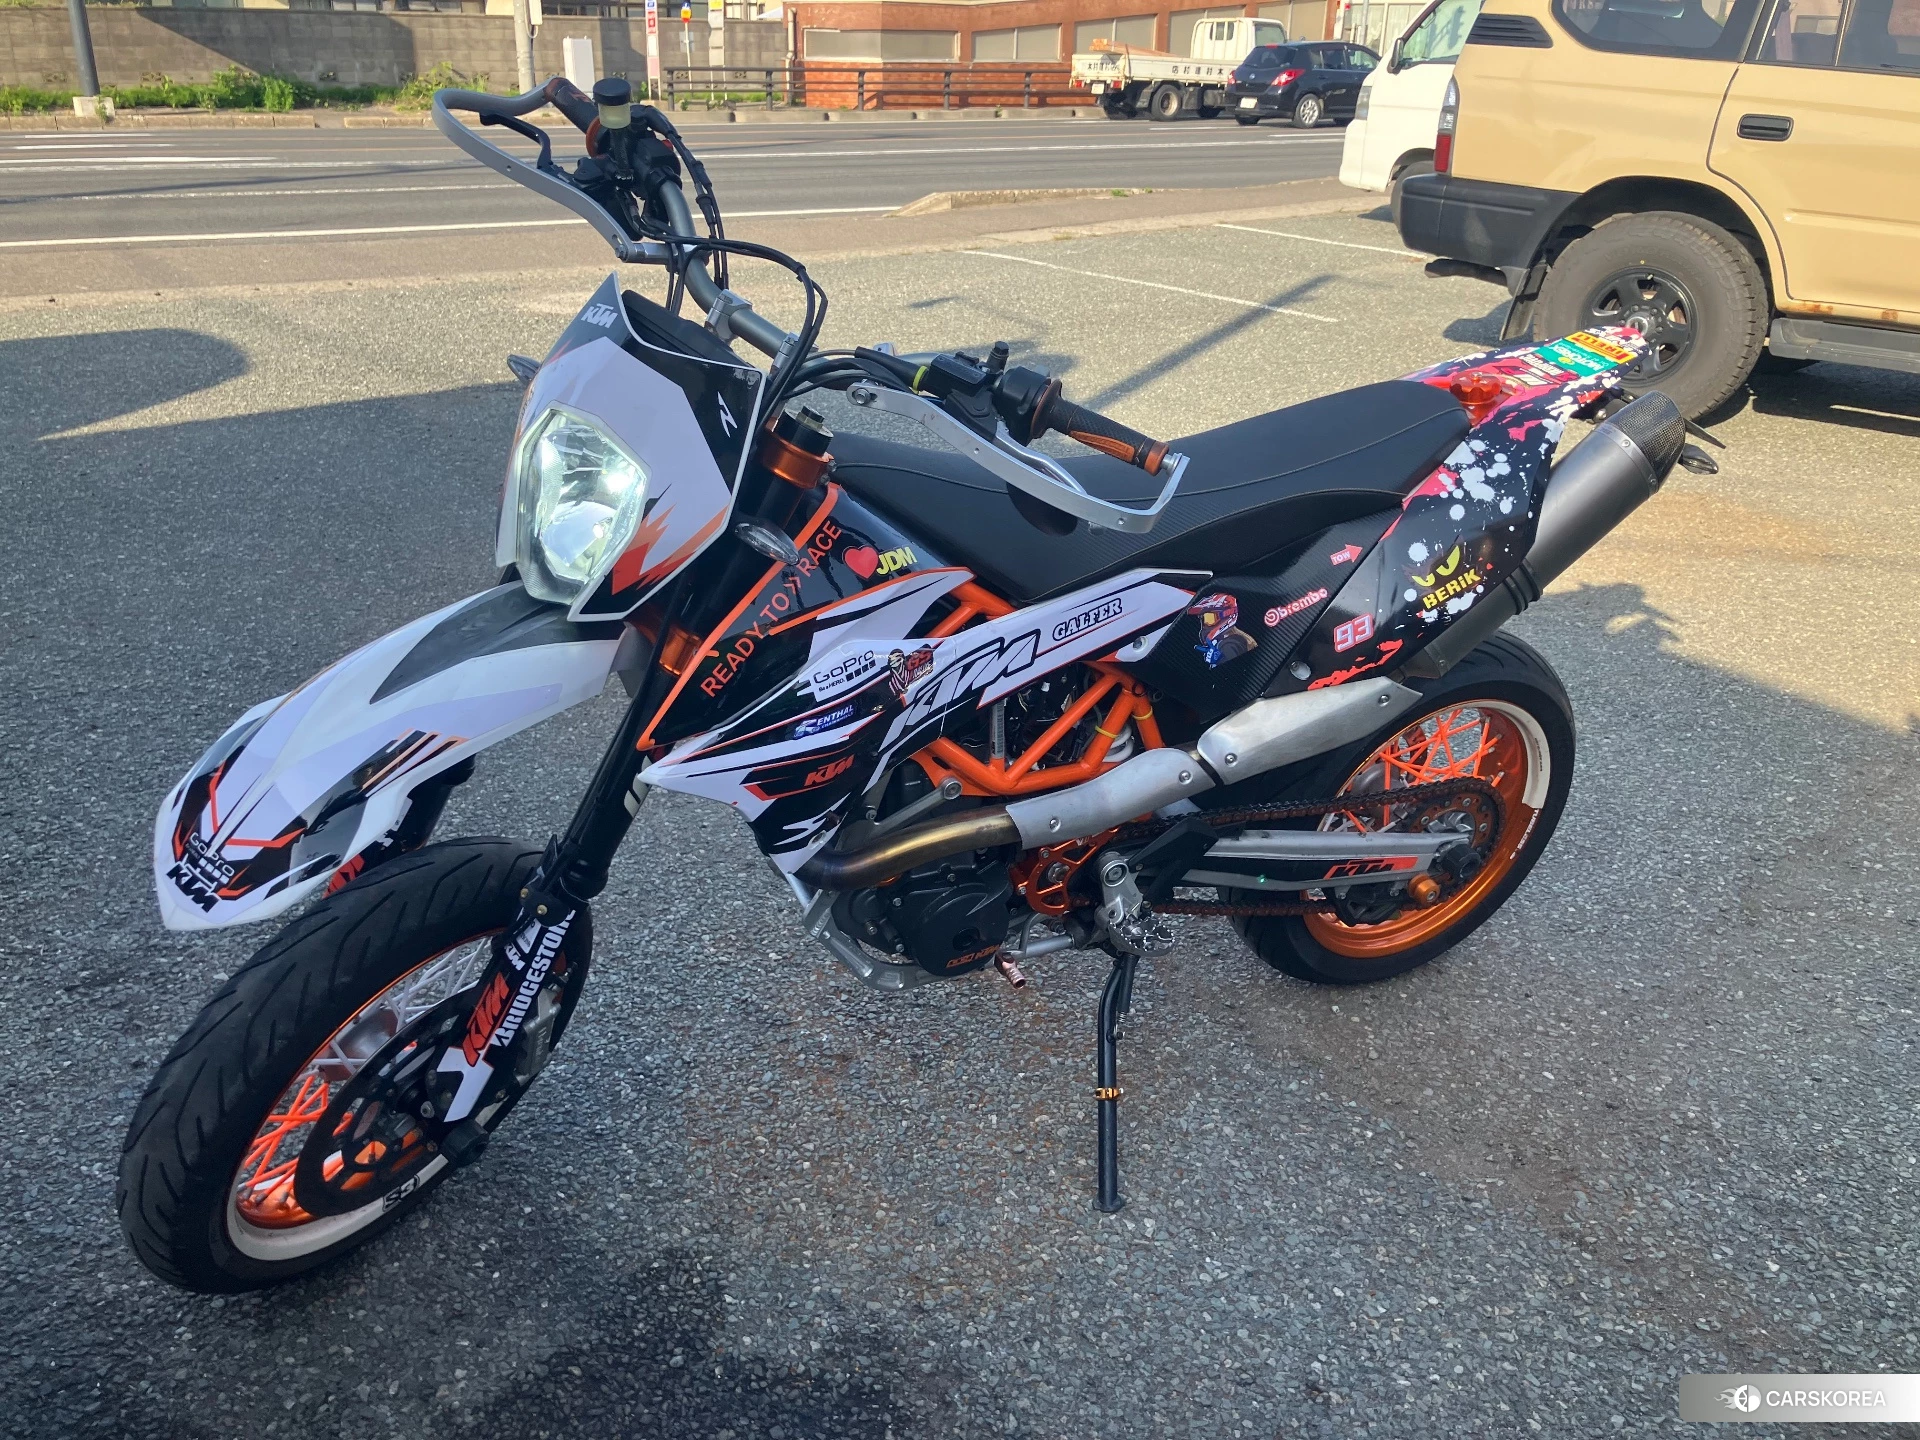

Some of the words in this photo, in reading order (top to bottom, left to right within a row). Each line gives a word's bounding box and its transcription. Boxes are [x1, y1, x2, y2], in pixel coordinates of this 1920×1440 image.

[581, 303, 618, 328] KTM
[1570, 333, 1631, 361] PIRELLI
[876, 546, 918, 575] JDM
[1332, 551, 1351, 564] TOW
[700, 621, 766, 698] READY
[759, 592, 790, 623] TO
[796, 520, 842, 578] RACE
[1052, 598, 1123, 641] GALFER
[1277, 588, 1328, 619] brembo
[1336, 615, 1373, 652] 93
[813, 650, 875, 684] GoPro
[880, 629, 1041, 750] KTM
[804, 754, 855, 787] KTM
[190, 831, 235, 877] GoPro
[1329, 859, 1395, 878] KTM
[166, 857, 221, 913] KTM
[505, 942, 526, 971] KTM
[490, 909, 576, 1048] BRIDGESTON
[462, 971, 510, 1068] KTM
